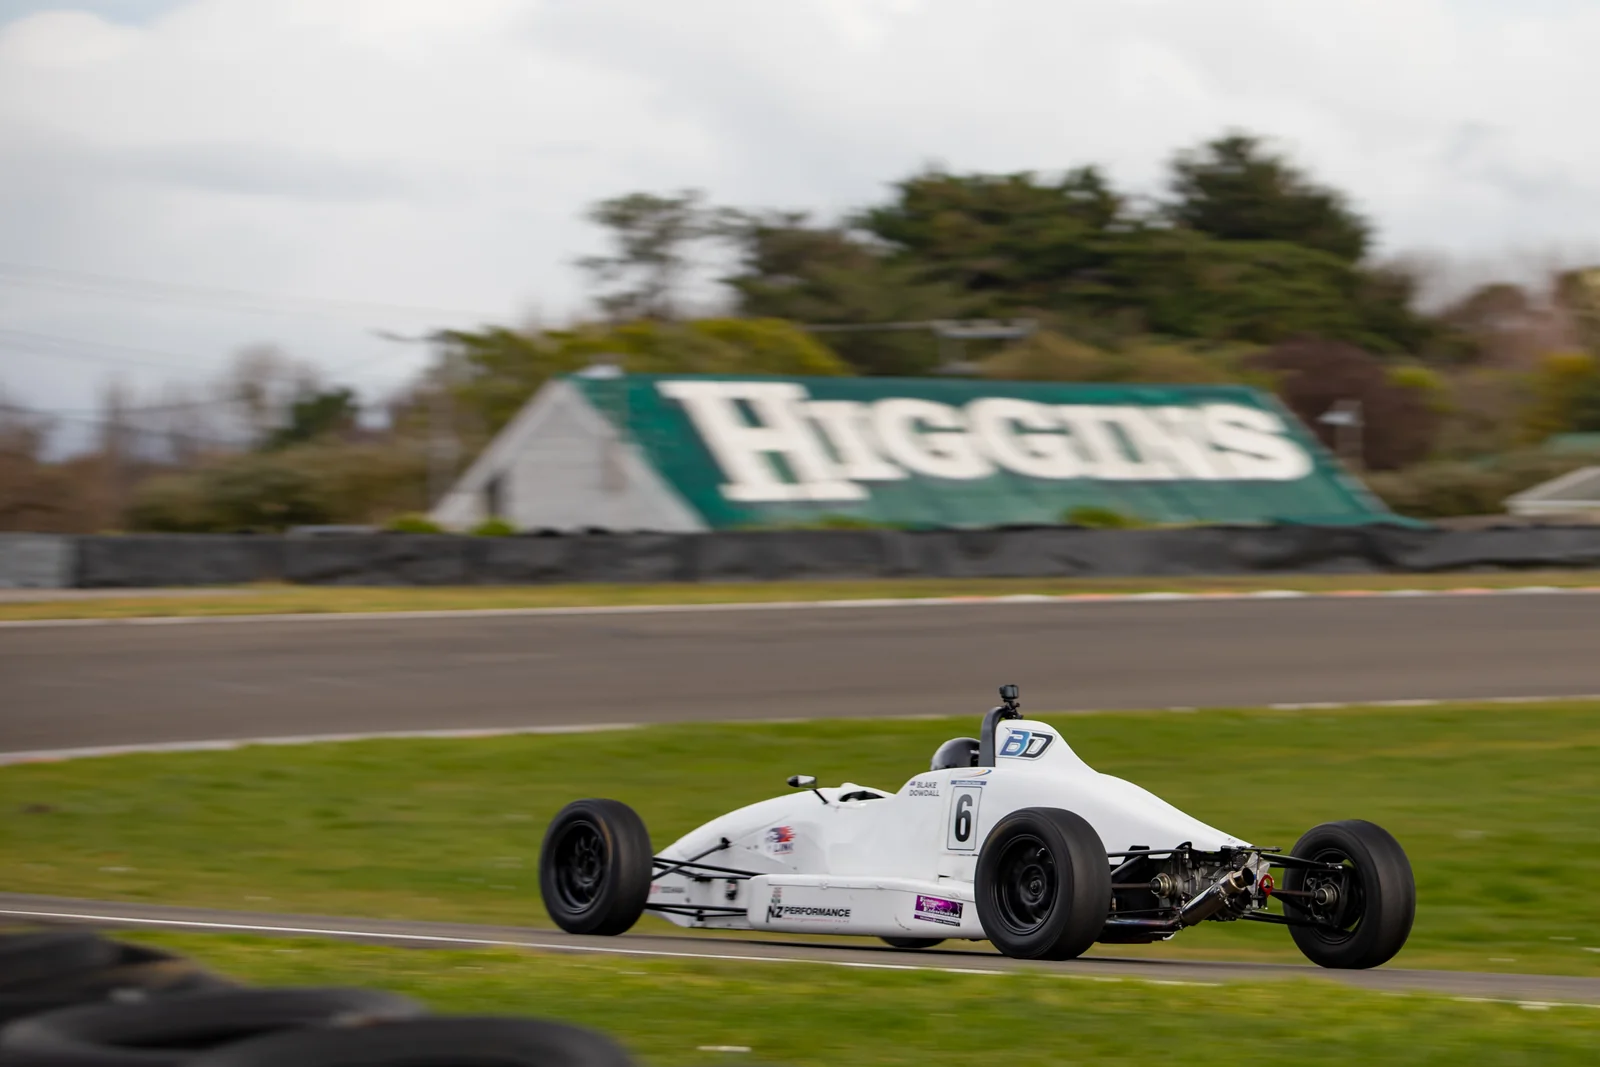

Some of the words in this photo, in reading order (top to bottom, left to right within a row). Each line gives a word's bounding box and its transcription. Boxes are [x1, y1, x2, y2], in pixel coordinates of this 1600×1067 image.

[658, 380, 1313, 502] HIGGINS
[999, 729, 1054, 759] BD
[909, 789, 940, 797] DOWDALL
[916, 781, 937, 789] BLAKE
[954, 793, 973, 843] 6
[766, 905, 784, 923] NZ
[784, 906, 851, 918] PERFORMANCE
